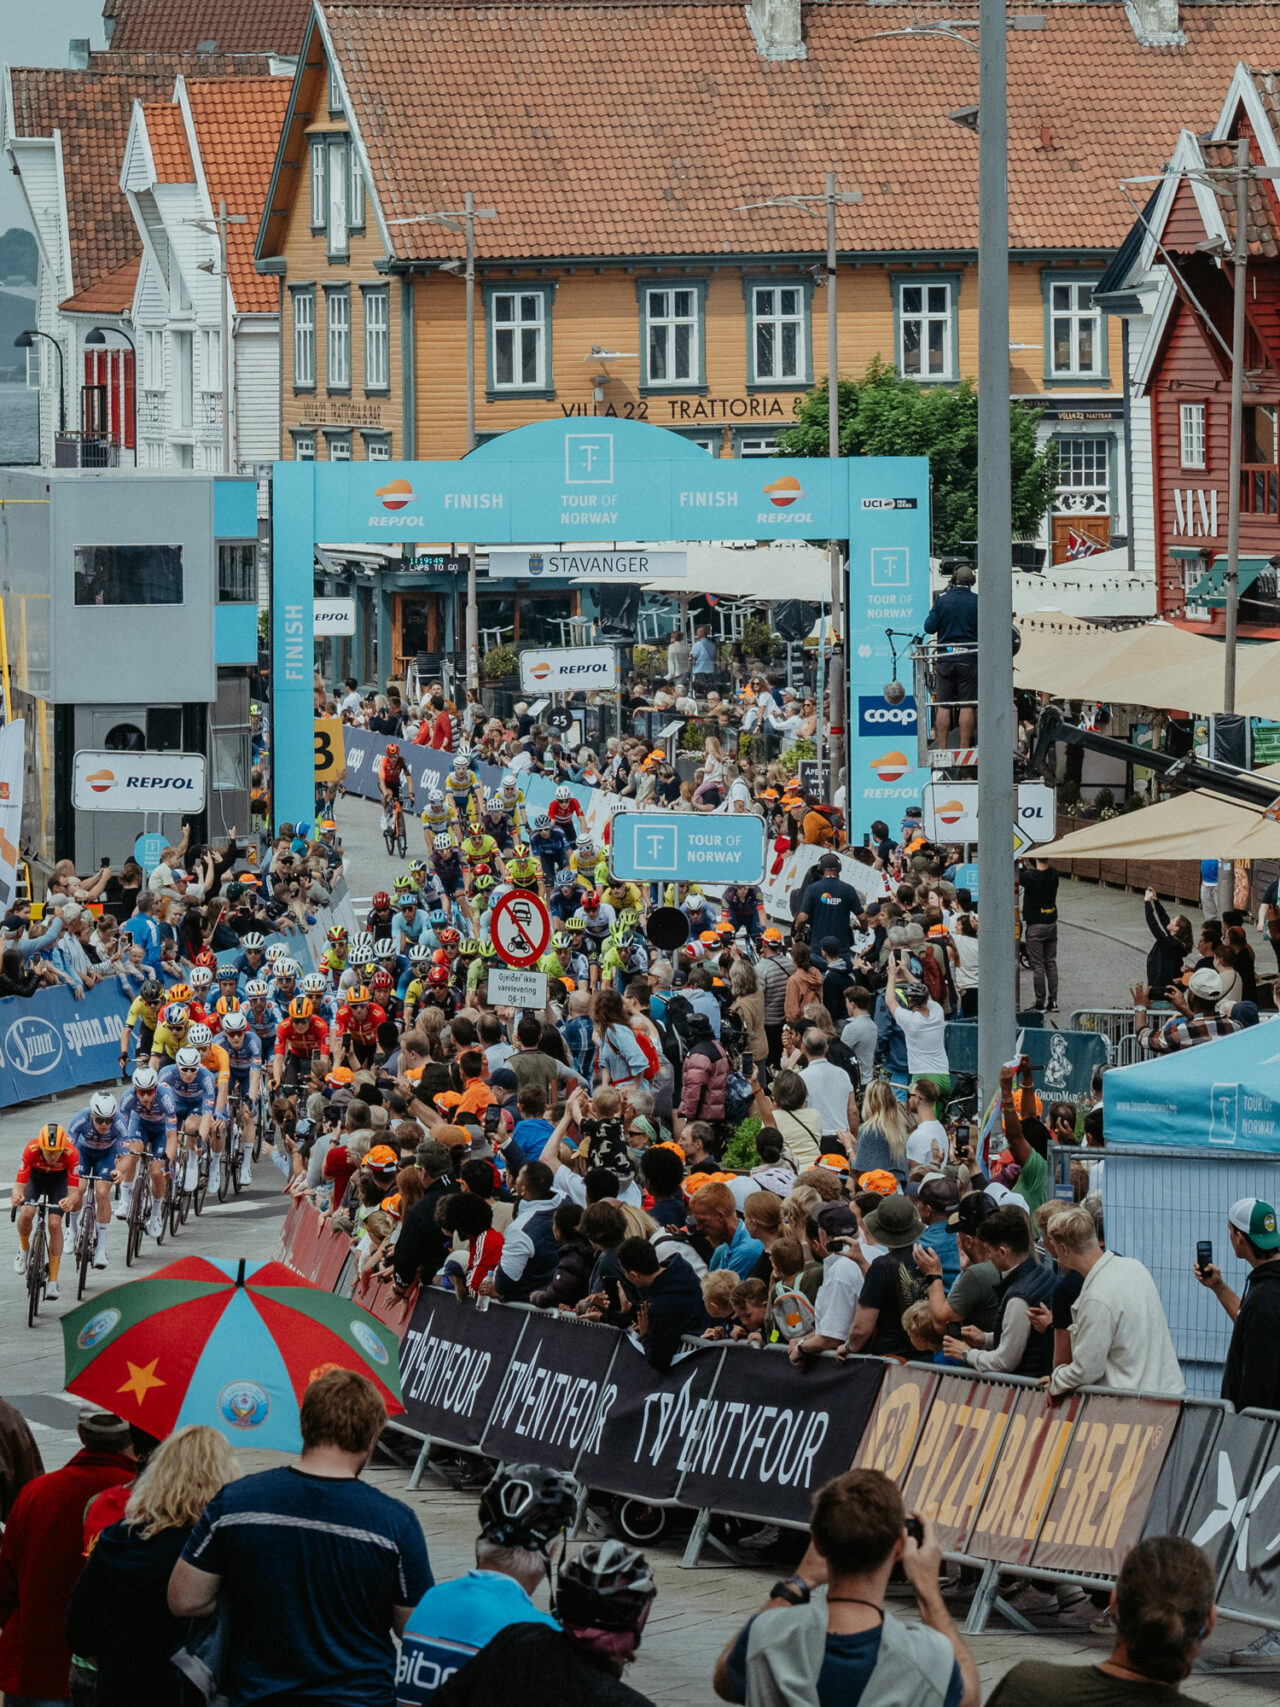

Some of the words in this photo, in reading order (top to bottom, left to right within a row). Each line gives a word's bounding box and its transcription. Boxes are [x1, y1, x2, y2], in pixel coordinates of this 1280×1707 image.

[670, 398, 784, 419] TRATTORIA
[445, 493, 504, 509] FINISH
[561, 495, 598, 507] TOUR
[601, 495, 618, 507] OF
[680, 491, 739, 507] FINISH
[863, 500, 882, 508] UCI
[368, 516, 425, 527] REPSOL
[560, 512, 618, 525] NORWAY
[756, 512, 814, 524] REPSOL
[409, 564, 430, 572] LAPS
[434, 564, 444, 572] TO
[448, 564, 459, 572] GO
[548, 557, 649, 573] STAVANGER
[868, 595, 896, 605] TOUR
[899, 595, 913, 605] OF
[313, 612, 349, 621] EPSOL
[867, 608, 913, 618] NORWAY
[284, 604, 304, 680] FINISH
[559, 663, 609, 675] REPSOL
[552, 715, 568, 726] 25
[863, 708, 918, 726] coop
[346, 747, 365, 773] coop
[126, 776, 195, 789] REPSOL
[863, 787, 919, 799] REPSOL
[688, 835, 722, 846] TOUR
[725, 835, 742, 846] OF
[687, 851, 742, 863] NORWAY
[826, 897, 842, 906] NEP
[523, 975, 537, 984] ikke
[497, 985, 537, 996] varelevering
[63, 1013, 123, 1057] spinn.no
[12, 1020, 57, 1072] Spinn
[1243, 1095, 1263, 1113] TOUR
[1241, 1118, 1275, 1136] NORWAY
[634, 1367, 829, 1489] TWENTYFOUR
